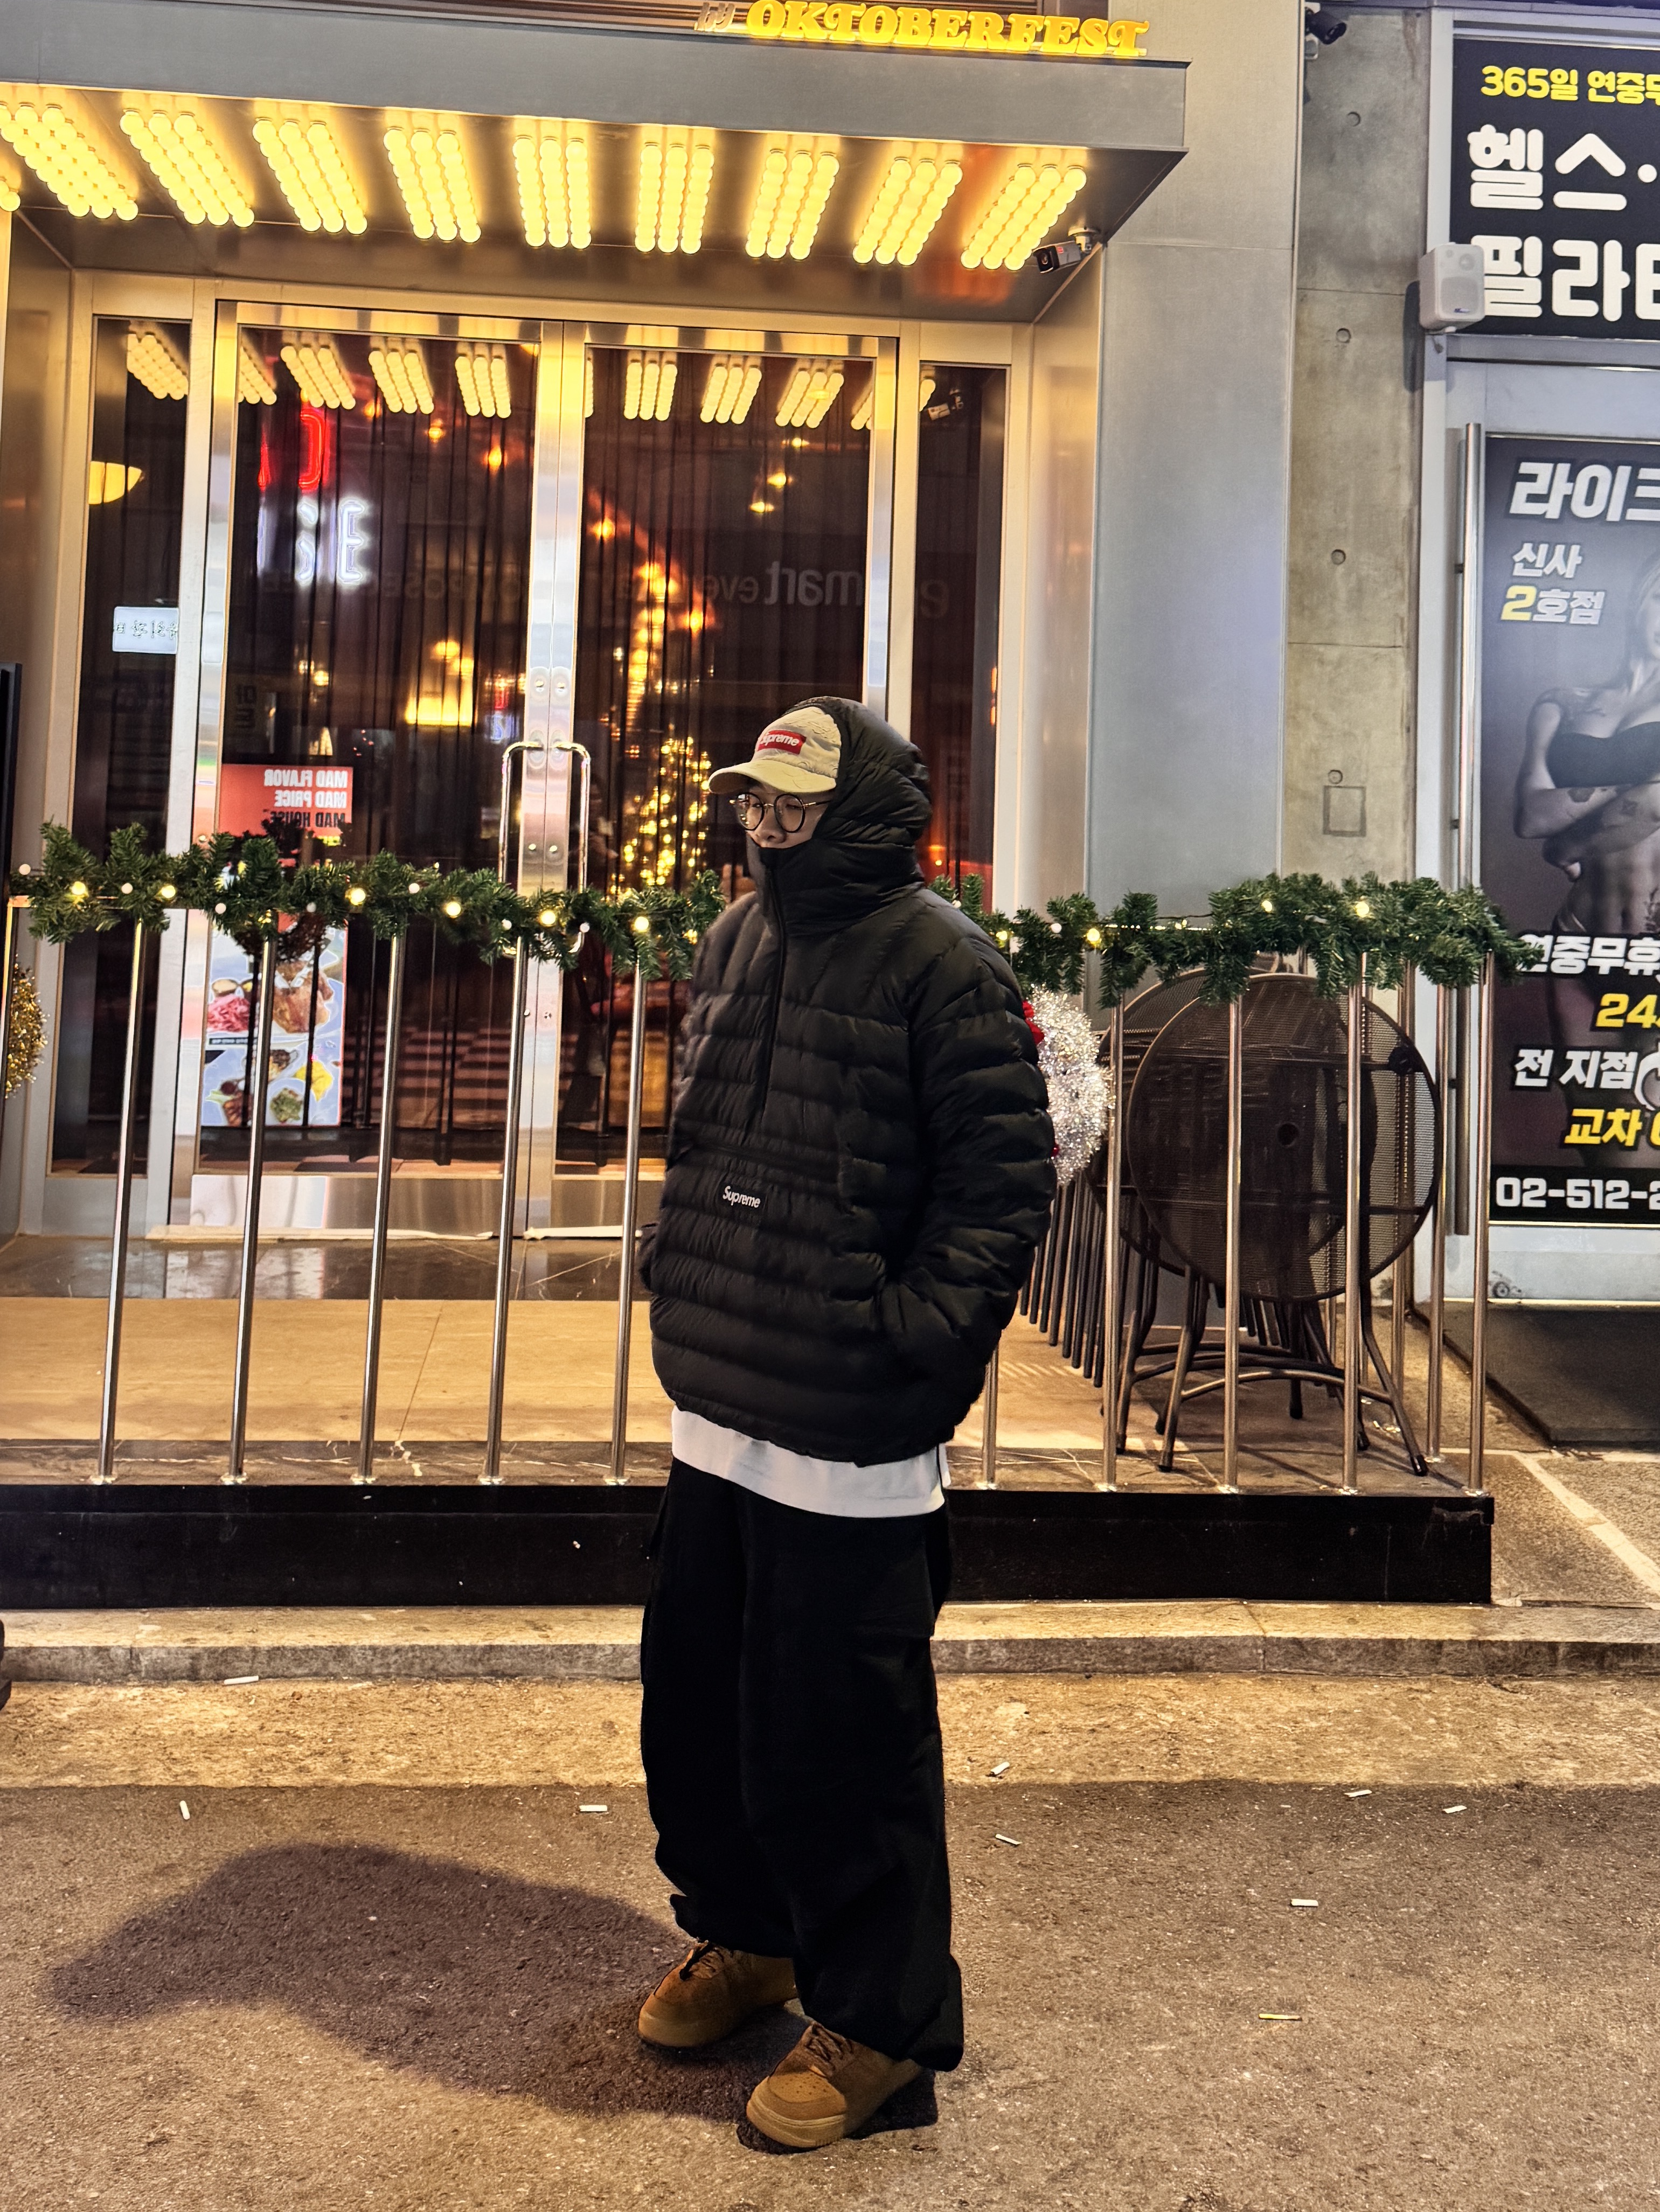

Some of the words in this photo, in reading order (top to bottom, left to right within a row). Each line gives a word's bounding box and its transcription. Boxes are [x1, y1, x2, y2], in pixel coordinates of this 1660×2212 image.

[746, 0, 1150, 57] OKTOBERFEST
[1481, 65, 1578, 101] 365일
[1512, 542, 1582, 579] 신사
[1501, 585, 1606, 625] 2호점
[1595, 993, 1660, 1028] 24
[1515, 1049, 1553, 1087] 전
[1560, 1051, 1638, 1089] 지점
[1564, 1108, 1642, 1147] 교차
[723, 1185, 761, 1208] Supreme
